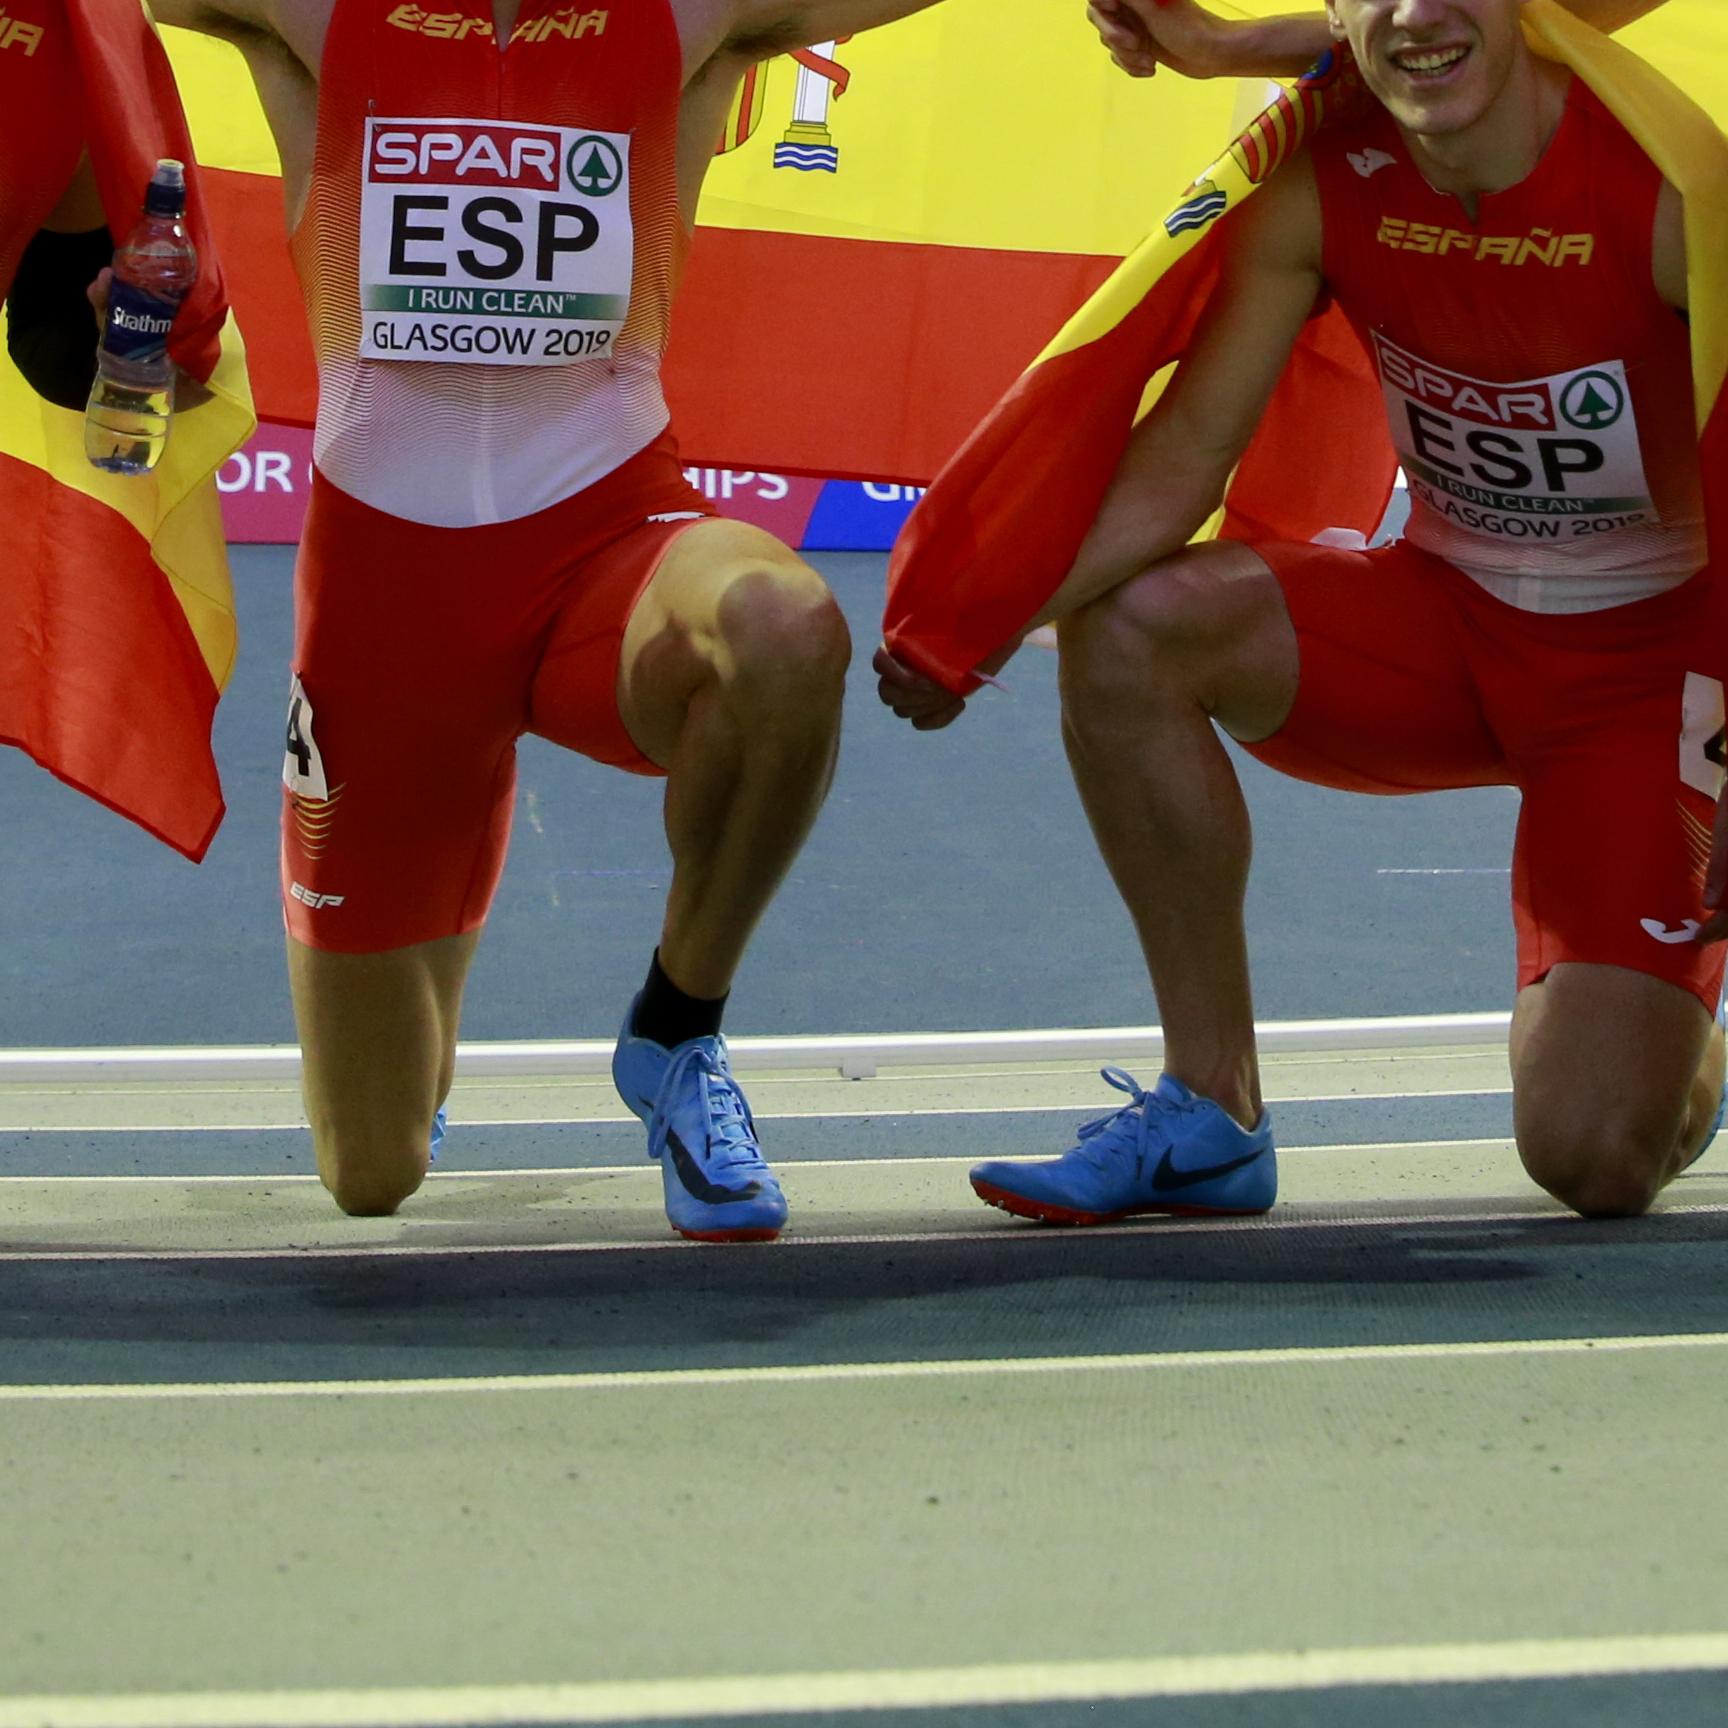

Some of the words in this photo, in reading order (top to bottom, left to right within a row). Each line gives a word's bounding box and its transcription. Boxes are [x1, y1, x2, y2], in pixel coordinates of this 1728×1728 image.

[385, 3, 609, 45] ESPAÑA
[374, 132, 556, 182] SPAR
[389, 194, 600, 282] ESP
[1378, 217, 1594, 267] ESPAÑA
[408, 288, 415, 308] I
[421, 289, 474, 310] RUN
[373, 321, 536, 355] GLASGOW
[543, 328, 611, 357] 2019
[1379, 346, 1550, 425] SPAR
[1405, 399, 1605, 492] ESP
[1410, 478, 1561, 538] GLASGOW
[1570, 513, 1646, 537] 2019
[1447, 479, 1496, 507] RUN
[286, 697, 312, 777] 4
[289, 881, 345, 910] ESP
